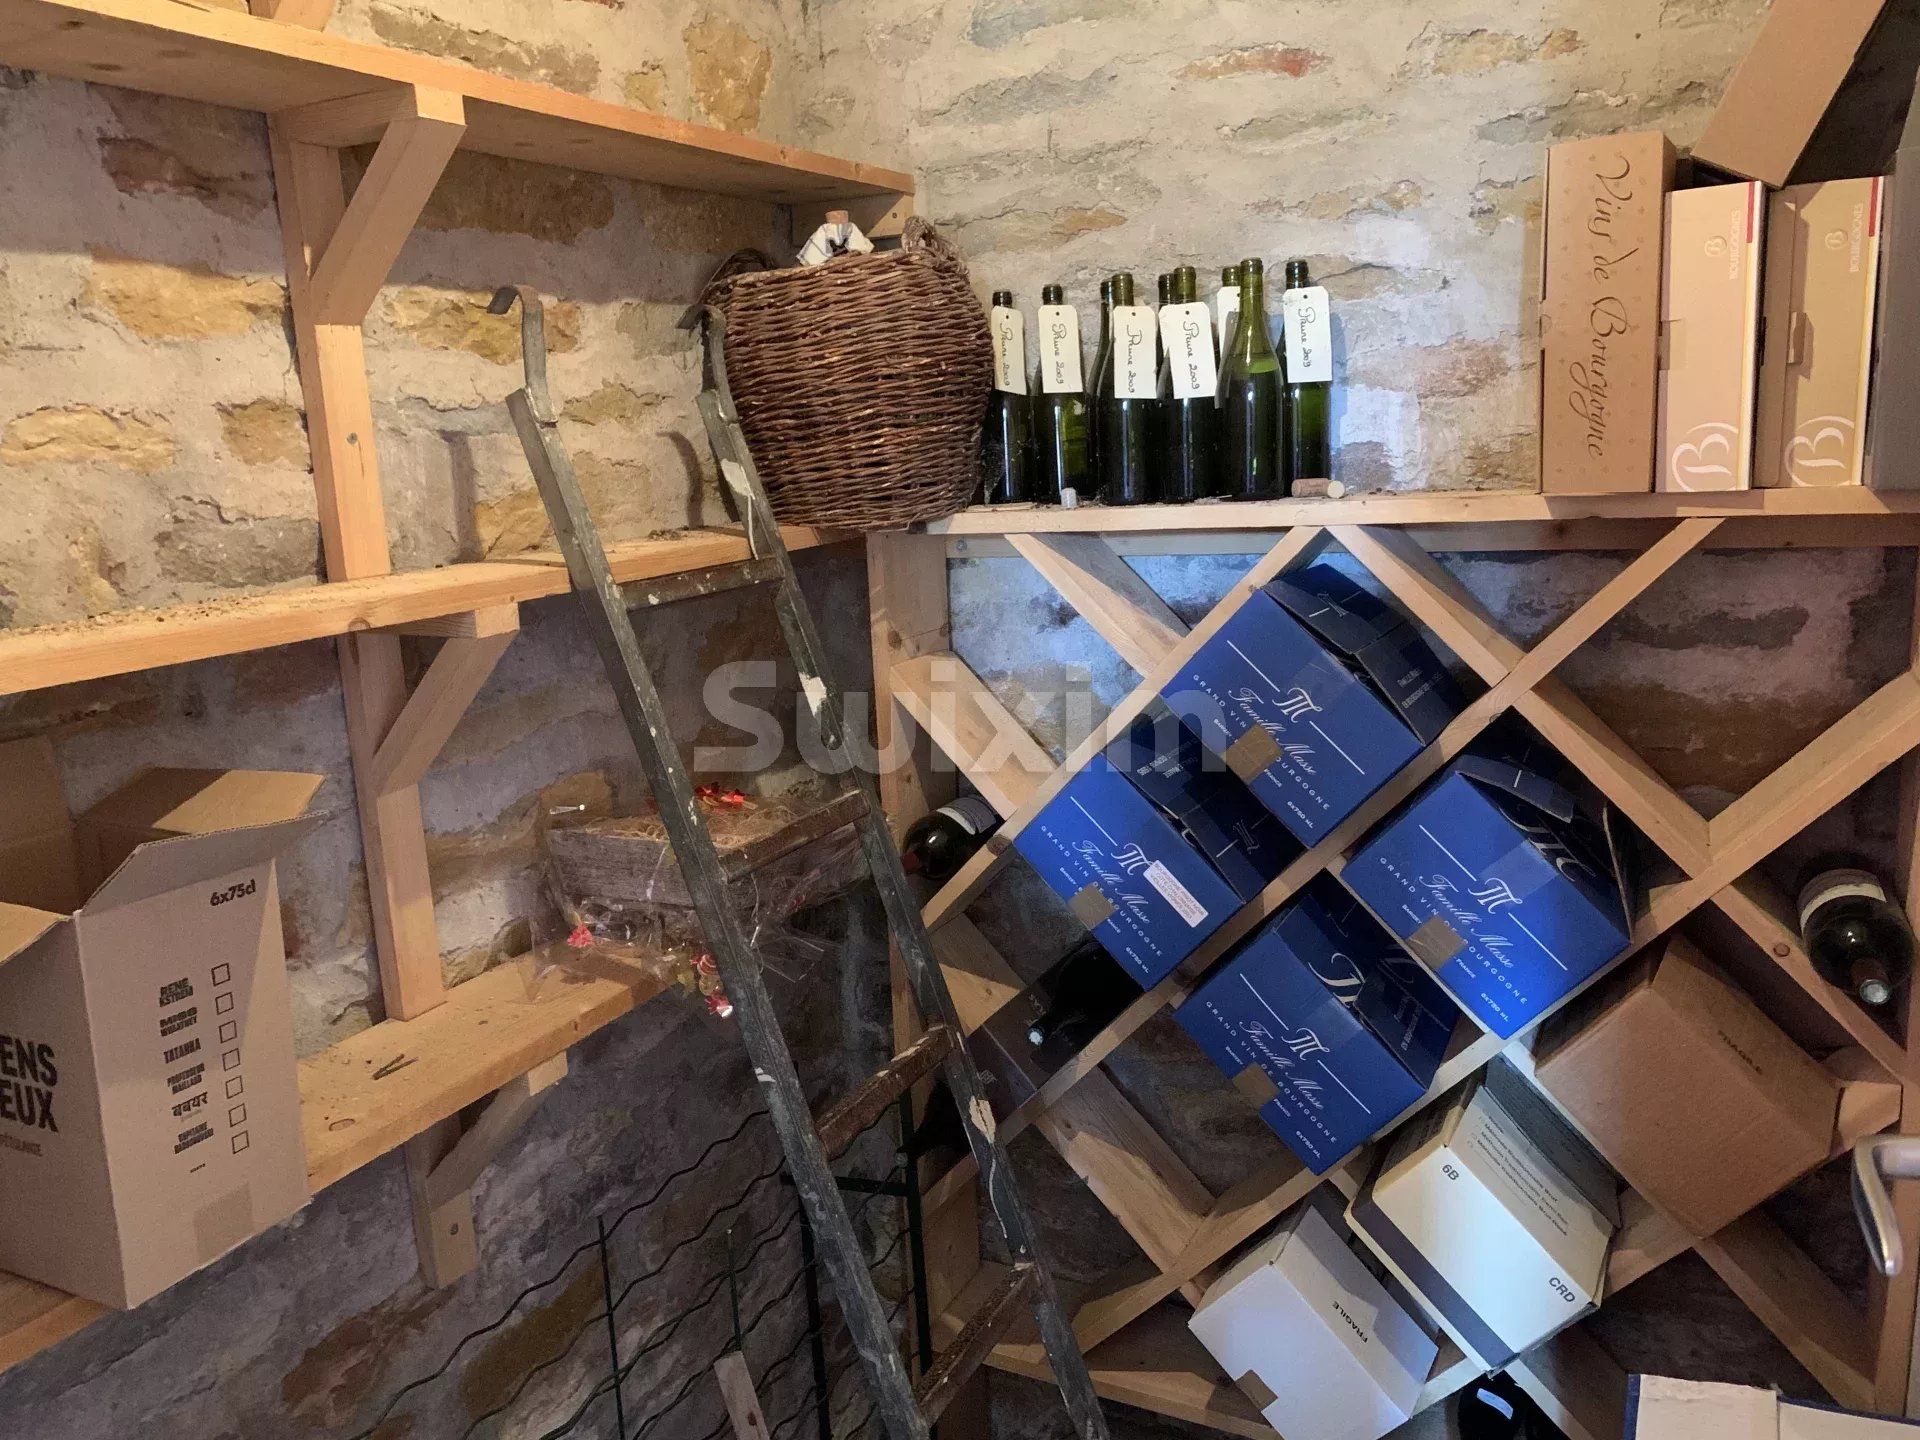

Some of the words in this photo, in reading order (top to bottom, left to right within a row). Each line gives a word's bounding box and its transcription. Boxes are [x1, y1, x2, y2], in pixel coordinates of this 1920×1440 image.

[1587, 155, 1633, 243] Vins
[1593, 247, 1640, 283] de
[1569, 296, 1629, 458] Bourgogne
[1193, 674, 1226, 707] GRAND
[1230, 710, 1247, 728] VIN
[1275, 756, 1330, 811] OURGOGNE
[1041, 825, 1071, 857] GRAND
[1074, 860, 1090, 877] VIN
[1380, 857, 1416, 894] GRAND
[1420, 896, 1439, 917] VIN
[1206, 1001, 1237, 1038] GRAND
[1241, 1041, 1257, 1059] VIN
[1277, 1081, 1338, 1144] BOURGOGNE
[1441, 1162, 1460, 1182] 6B
[1548, 1276, 1576, 1305] CRD
[1332, 1300, 1369, 1344] FRAGILE
